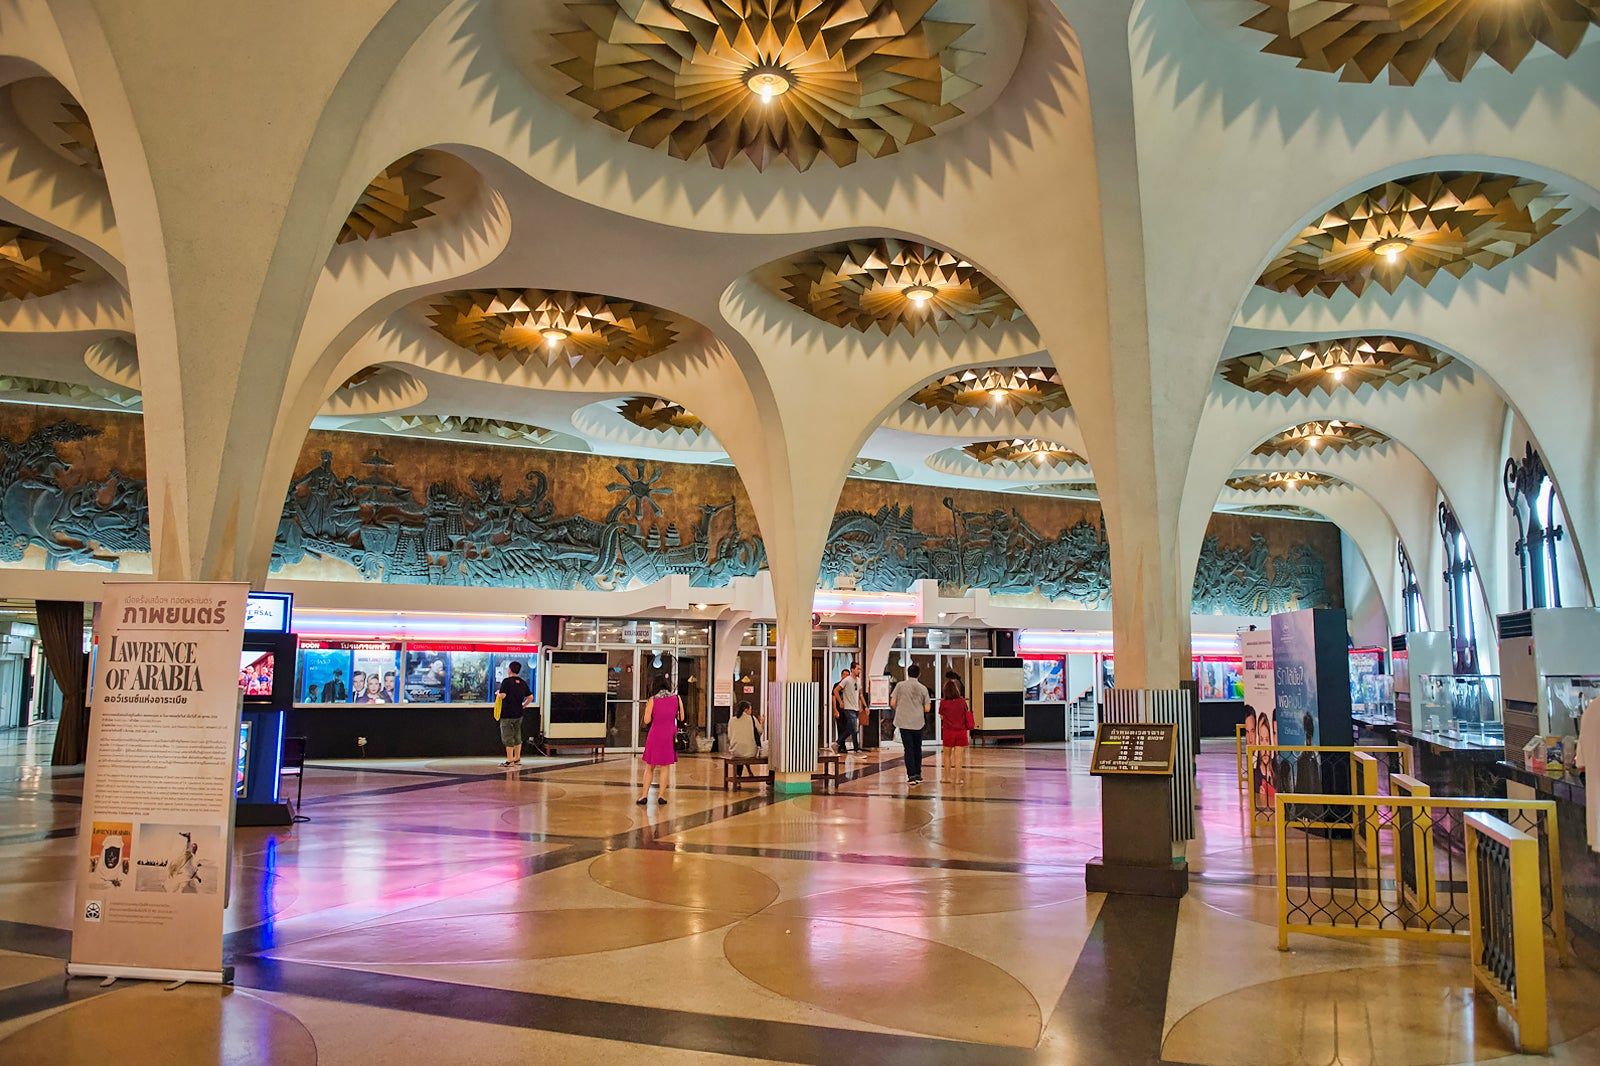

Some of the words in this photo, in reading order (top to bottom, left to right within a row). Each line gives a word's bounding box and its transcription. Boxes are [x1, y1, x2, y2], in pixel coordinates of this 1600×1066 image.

[122, 600, 227, 624] ภาพยนตร์
[109, 635, 198, 664] LAWRENCE
[105, 668, 130, 690] OF
[129, 664, 204, 691] ARABIA
[104, 694, 188, 704] ลอว์เรนซ์แห่งอาระเบีย
